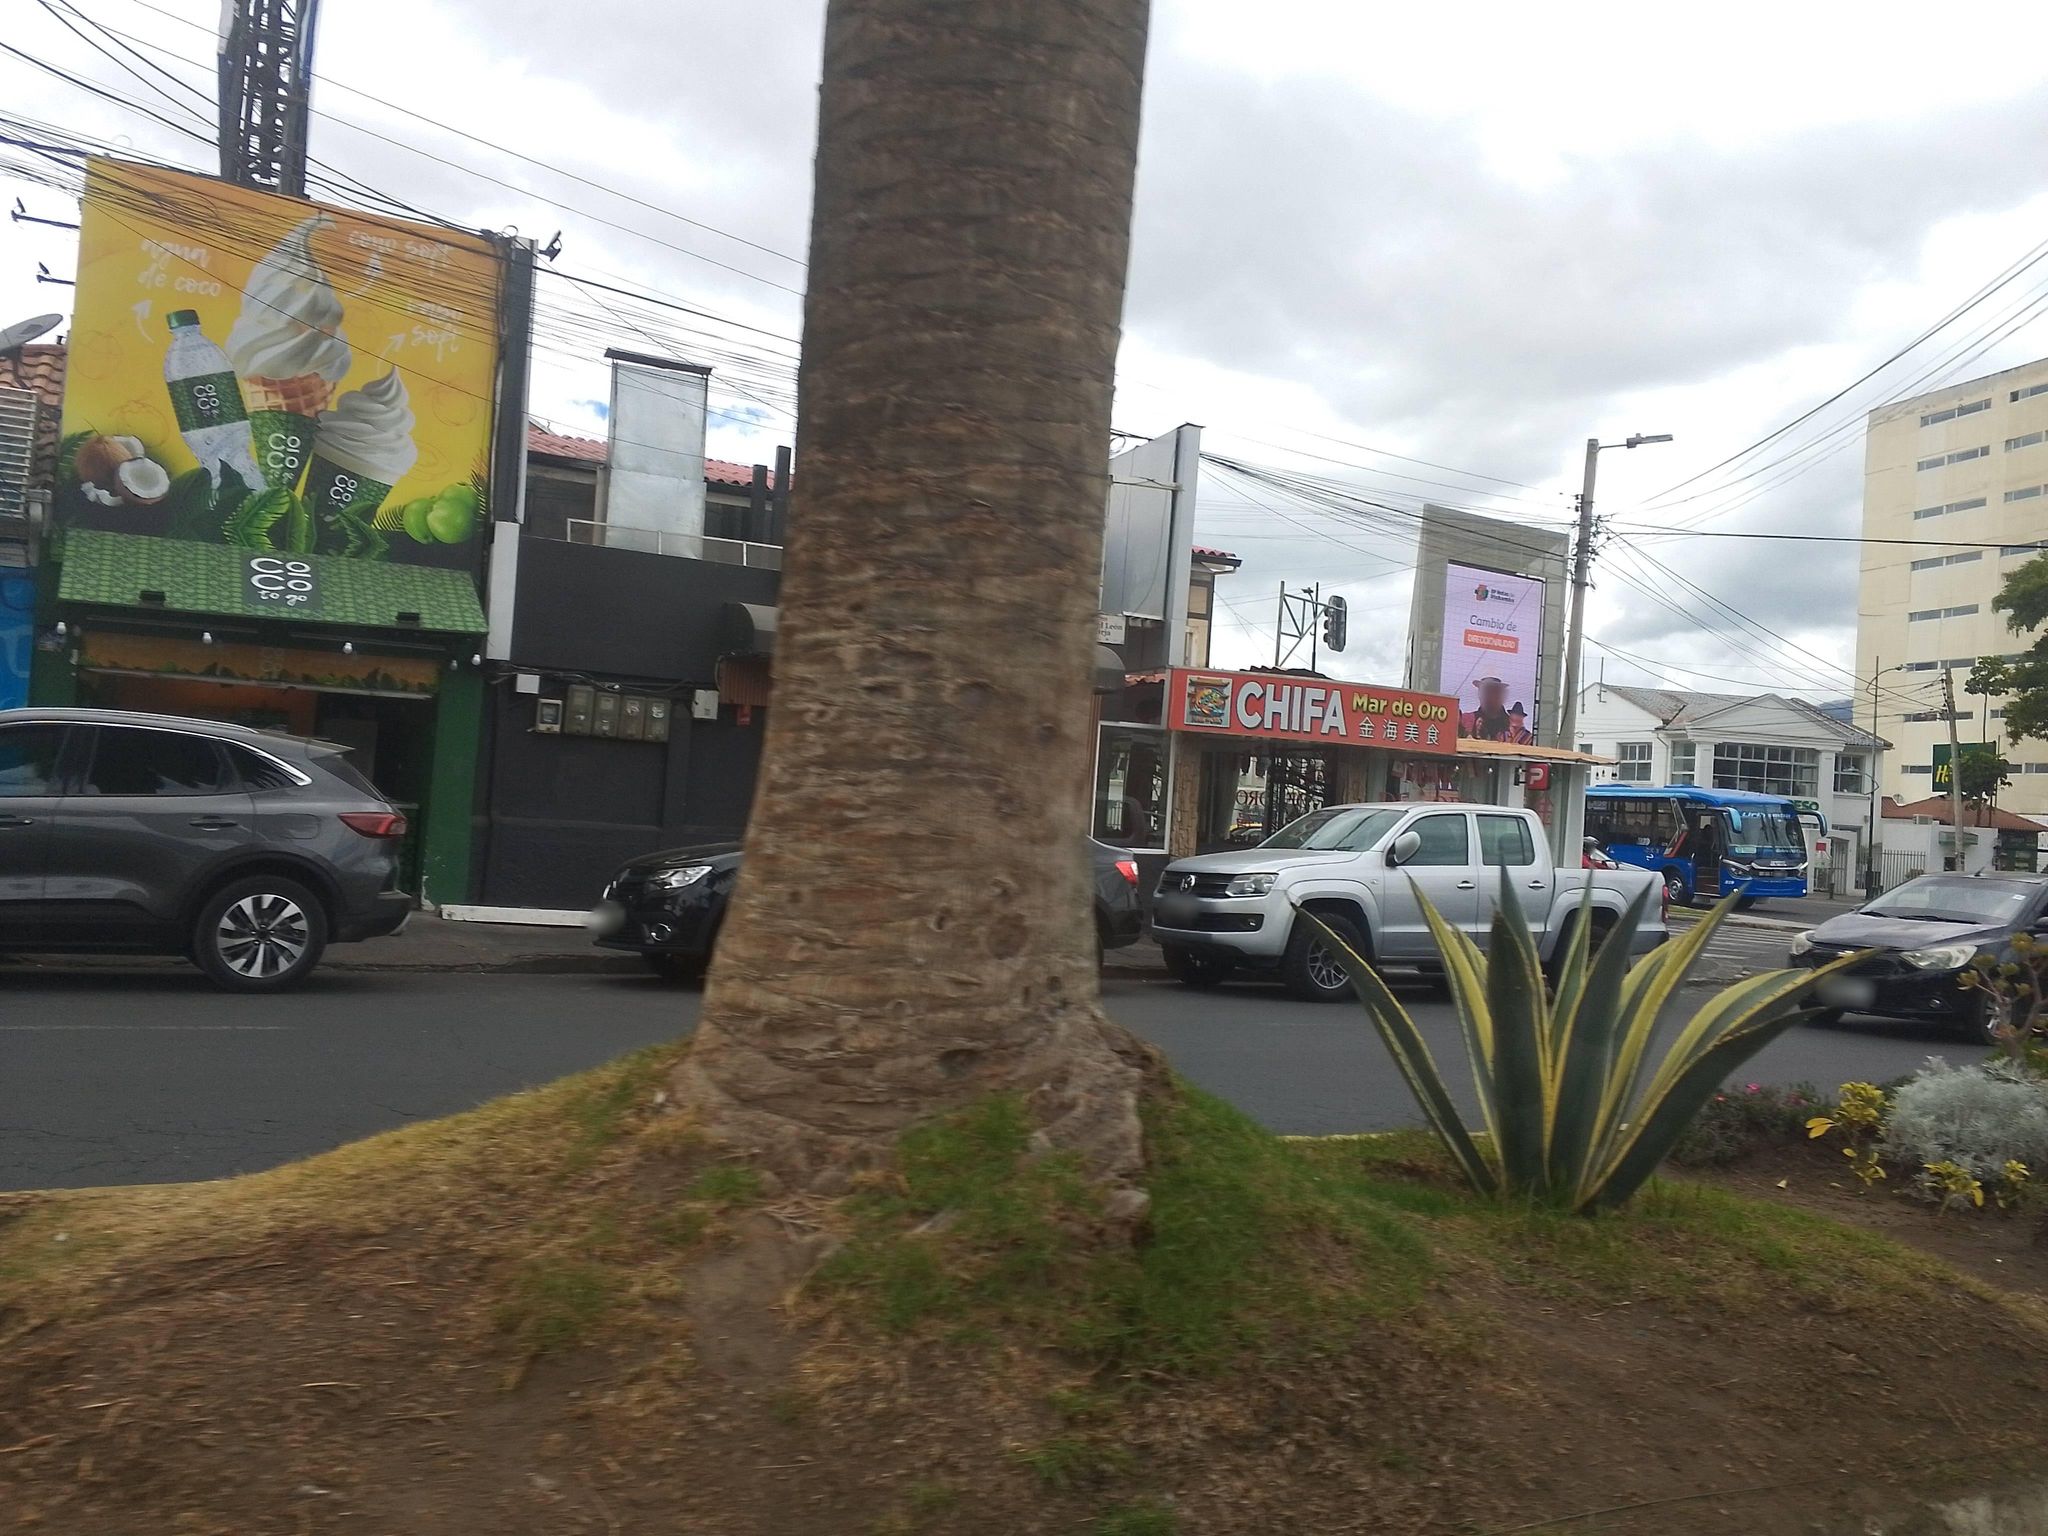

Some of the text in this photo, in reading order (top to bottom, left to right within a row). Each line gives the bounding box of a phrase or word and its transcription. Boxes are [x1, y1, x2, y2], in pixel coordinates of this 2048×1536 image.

[257, 590, 308, 607] to go
[1469, 614, 1517, 632] Cambio de
[1237, 681, 1347, 736] CHIFA
[1352, 692, 1448, 721] Mar de Oro
[1358, 716, 1441, 746] 金海美食
